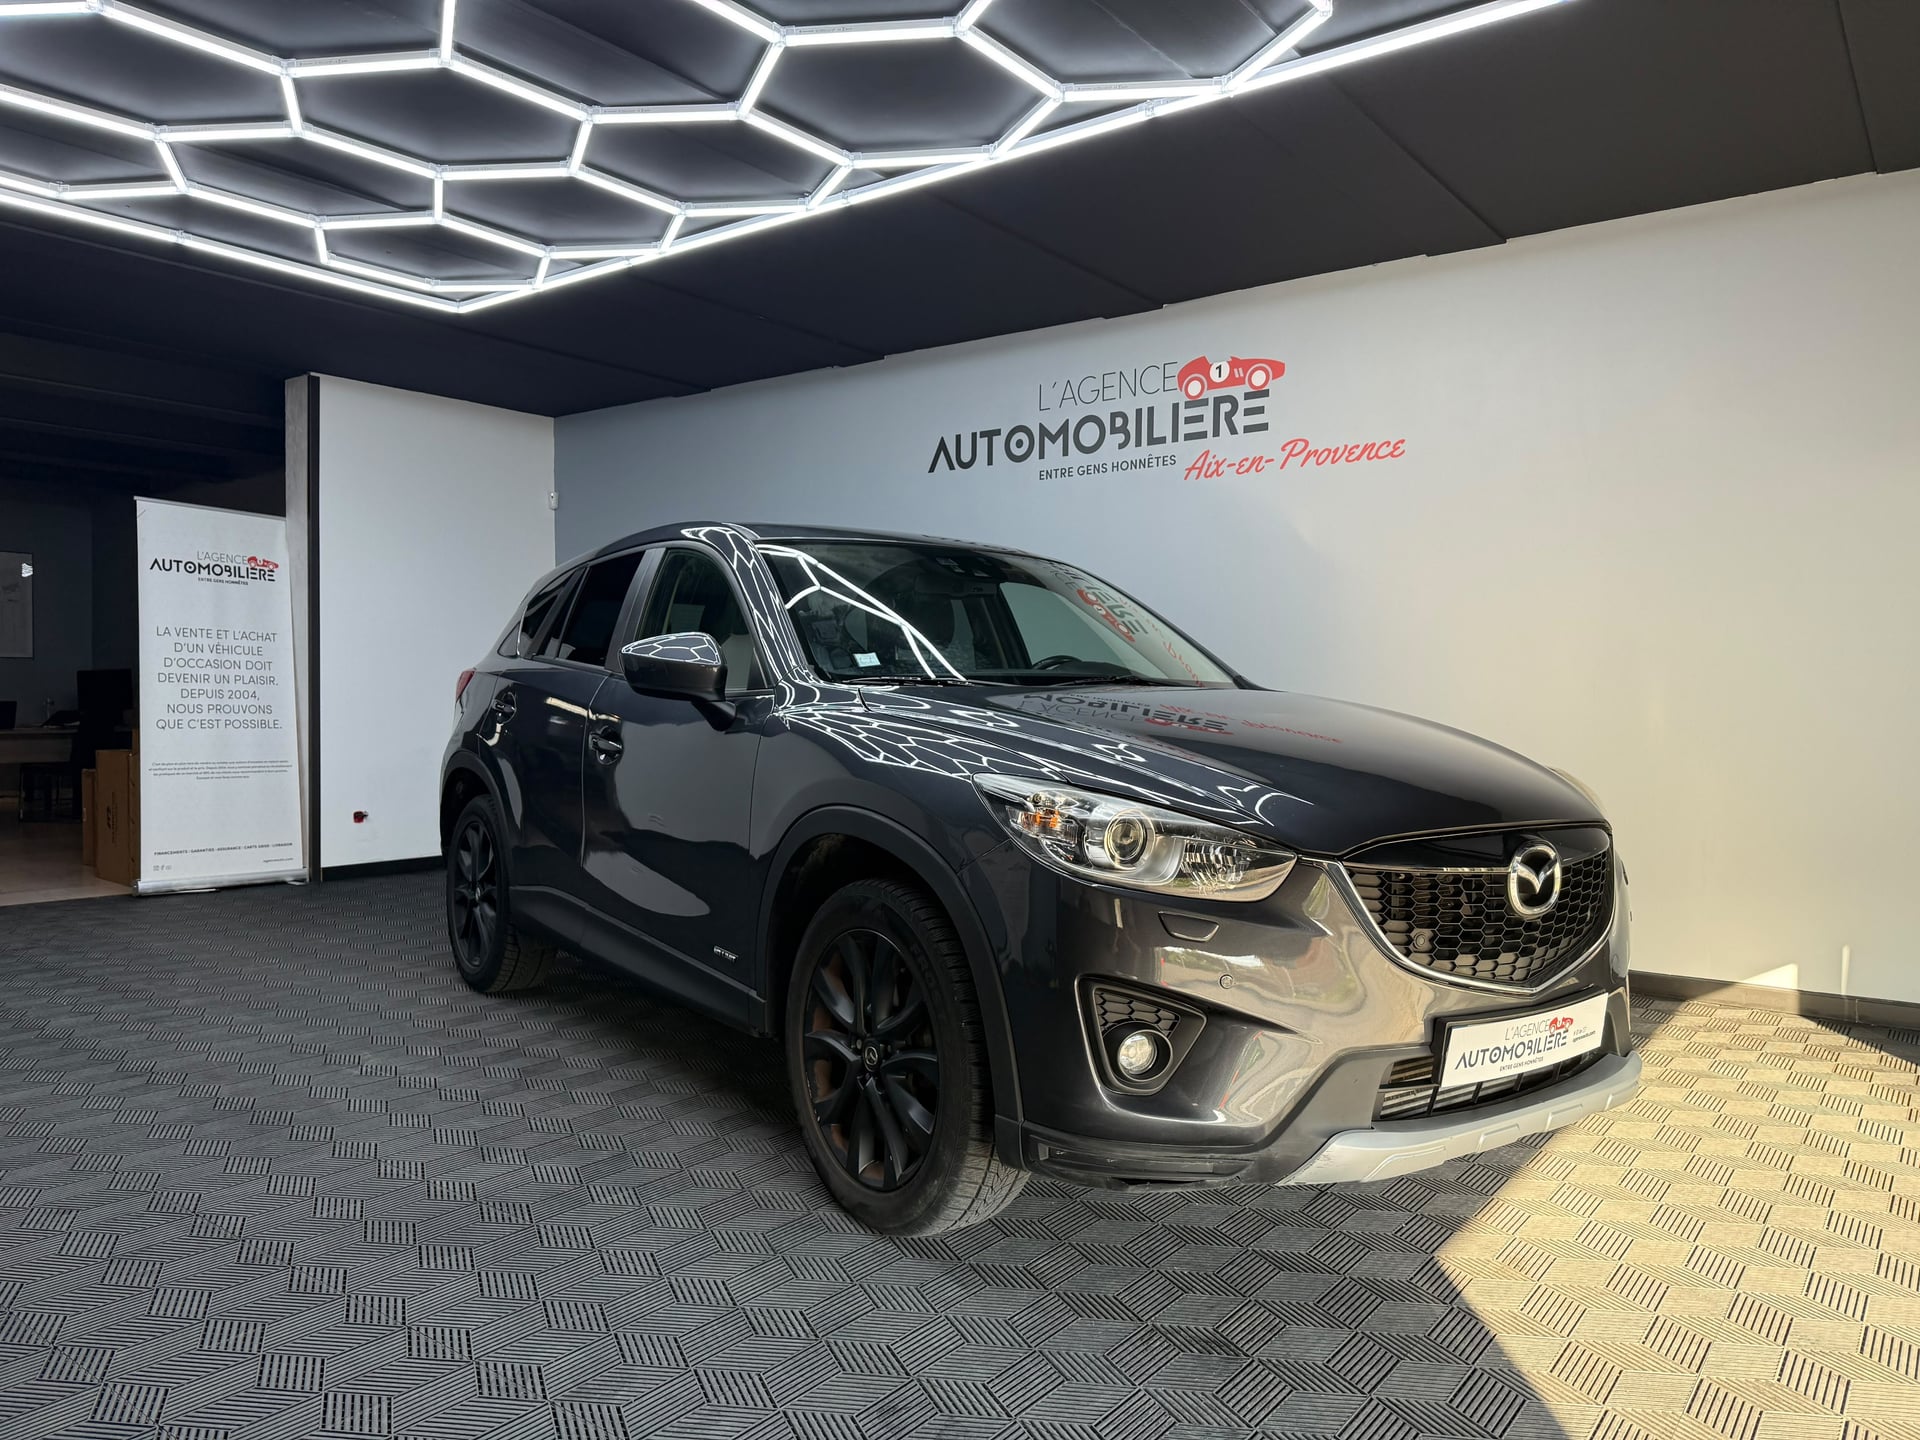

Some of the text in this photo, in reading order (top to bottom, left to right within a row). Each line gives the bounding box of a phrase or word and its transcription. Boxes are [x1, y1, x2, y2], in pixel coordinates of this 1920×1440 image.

[1215, 364, 1223, 379] 1
[1039, 361, 1178, 411] L'AGENCE
[1039, 453, 1177, 480] ENTRE GENS HONNÊTES
[197, 551, 247, 564] L'AGENCE
[156, 626, 277, 643] LA VENTE ET L'ACHAT
[174, 642, 263, 656] D'UN VÉHICULE
[164, 657, 272, 671] D'OCCASION DOIT
[158, 673, 210, 684] DEVENIR
[214, 675, 230, 684] UN
[181, 689, 260, 701] DEPUIS 2004,
[167, 704, 272, 714] NOUS PROUVONS
[156, 719, 283, 730] QUE C'EST POSSIBLE.
[1505, 1019, 1549, 1040] L'AGENCE
